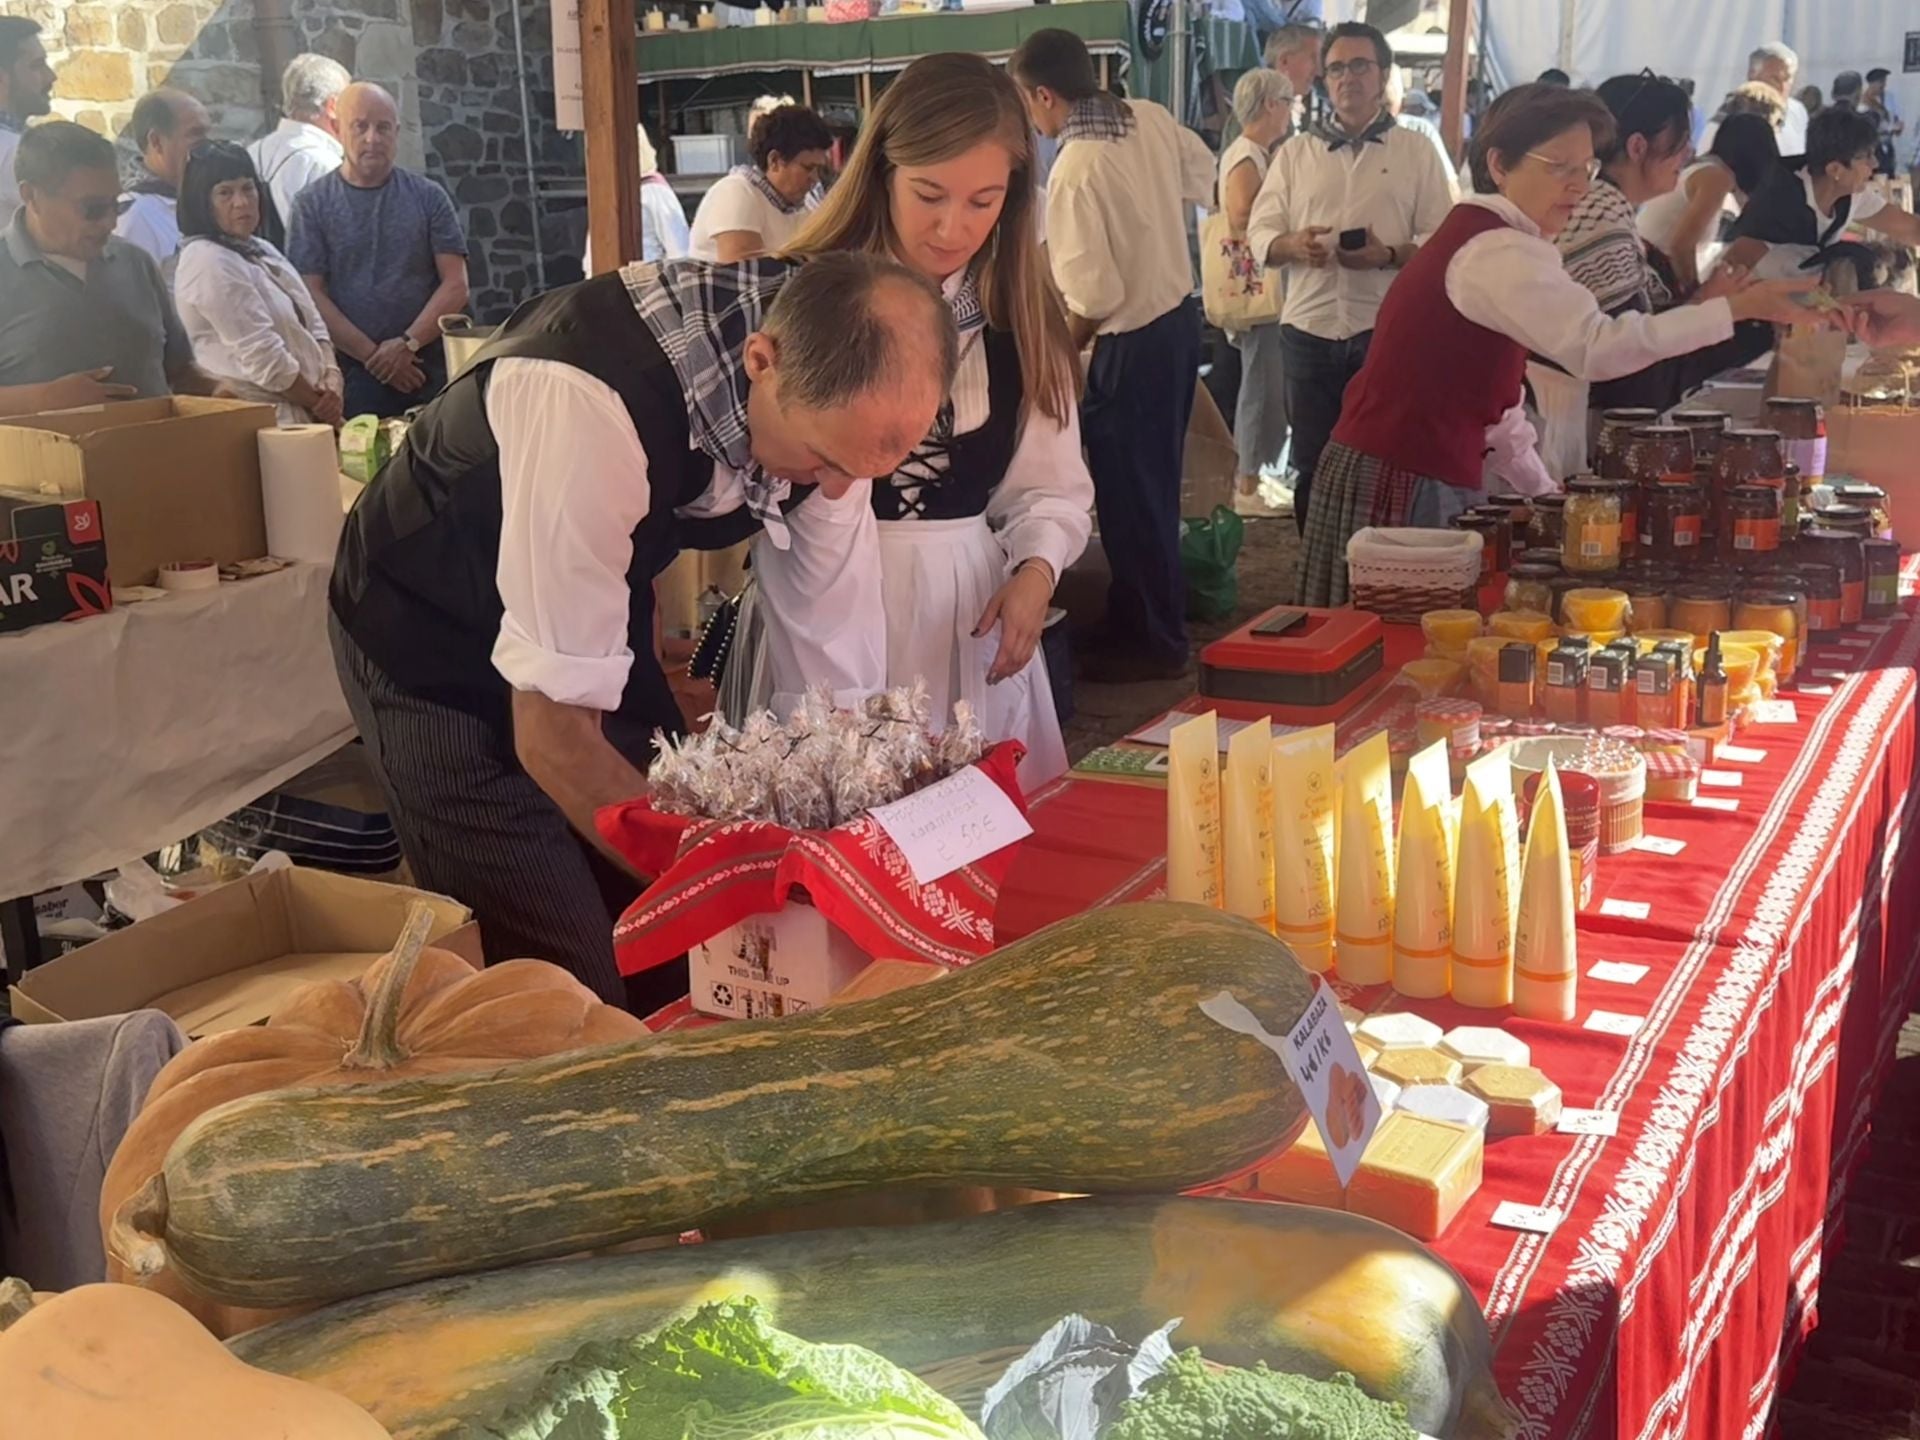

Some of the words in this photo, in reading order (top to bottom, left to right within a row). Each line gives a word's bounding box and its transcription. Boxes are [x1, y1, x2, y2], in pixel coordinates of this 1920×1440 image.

[728, 965, 750, 978] THIS
[775, 976, 790, 986] UP
[1293, 996, 1328, 1050] KALABAZA
